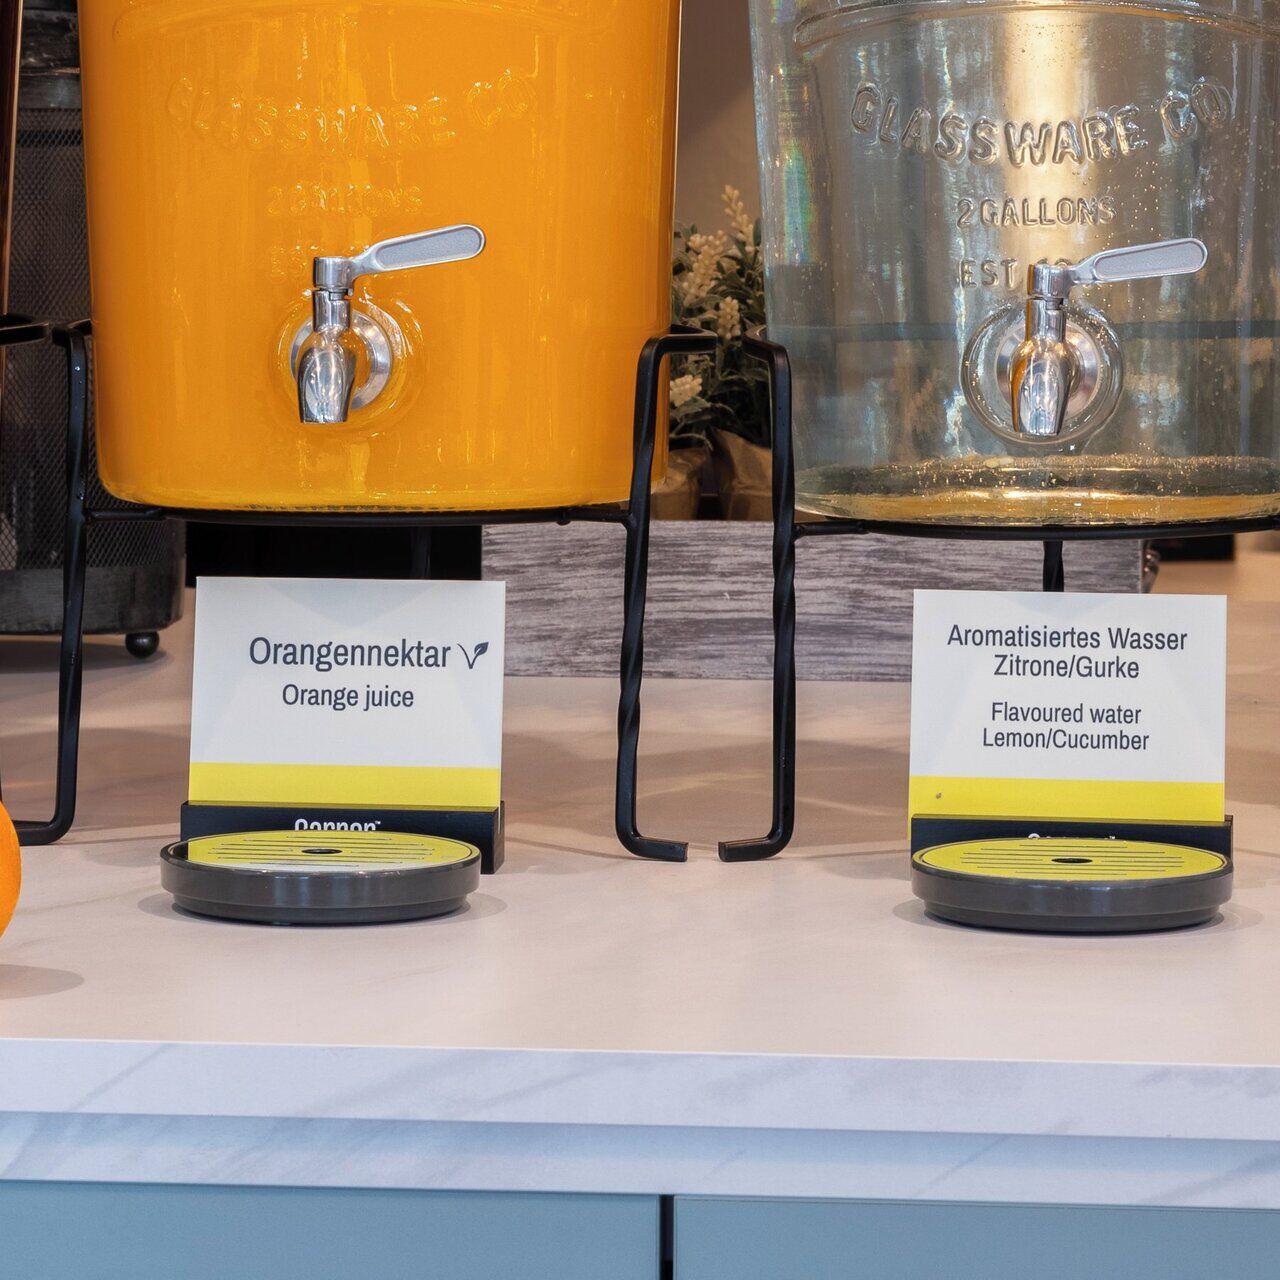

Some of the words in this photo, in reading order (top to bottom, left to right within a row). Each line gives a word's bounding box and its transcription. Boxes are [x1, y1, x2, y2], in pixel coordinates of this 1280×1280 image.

[850, 80, 1149, 167] GLASSWARE
[947, 624, 1101, 648] Aromatisiertes
[1108, 627, 1188, 650] Wasser
[249, 636, 451, 673] Orangennektar
[993, 654, 1140, 678] Zitrone/Gurke
[282, 684, 359, 711] Orange
[363, 684, 414, 712] juice
[992, 701, 1083, 723] Flavoured
[1089, 704, 1142, 725] water
[983, 727, 1149, 750] Lemon/Cucumber
